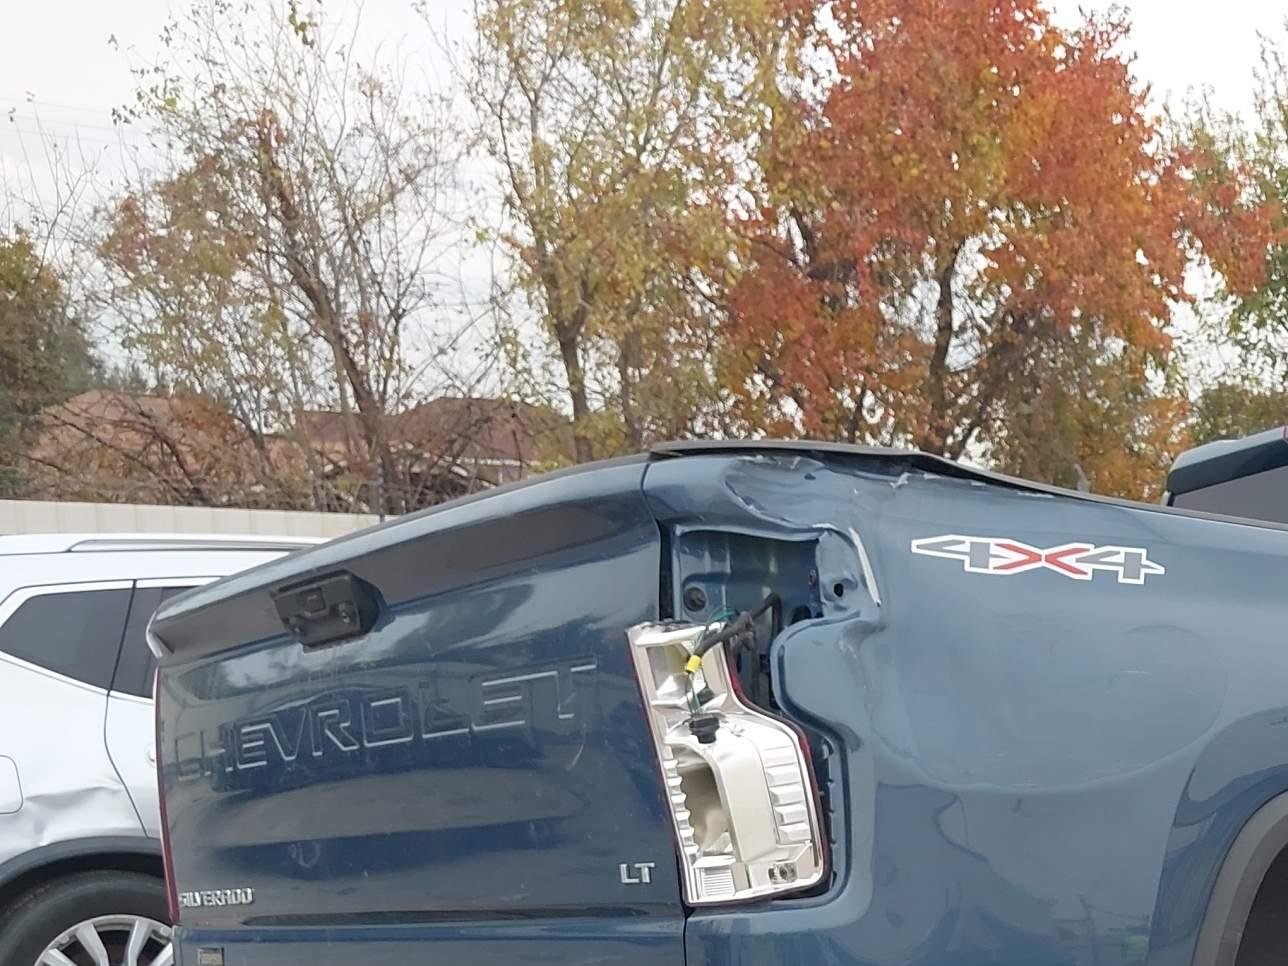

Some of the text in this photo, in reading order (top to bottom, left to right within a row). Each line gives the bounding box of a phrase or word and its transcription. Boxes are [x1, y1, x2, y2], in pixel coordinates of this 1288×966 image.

[174, 661, 597, 783] CHEVROLET
[620, 862, 655, 883] LT
[179, 887, 253, 907] SILVERADO
